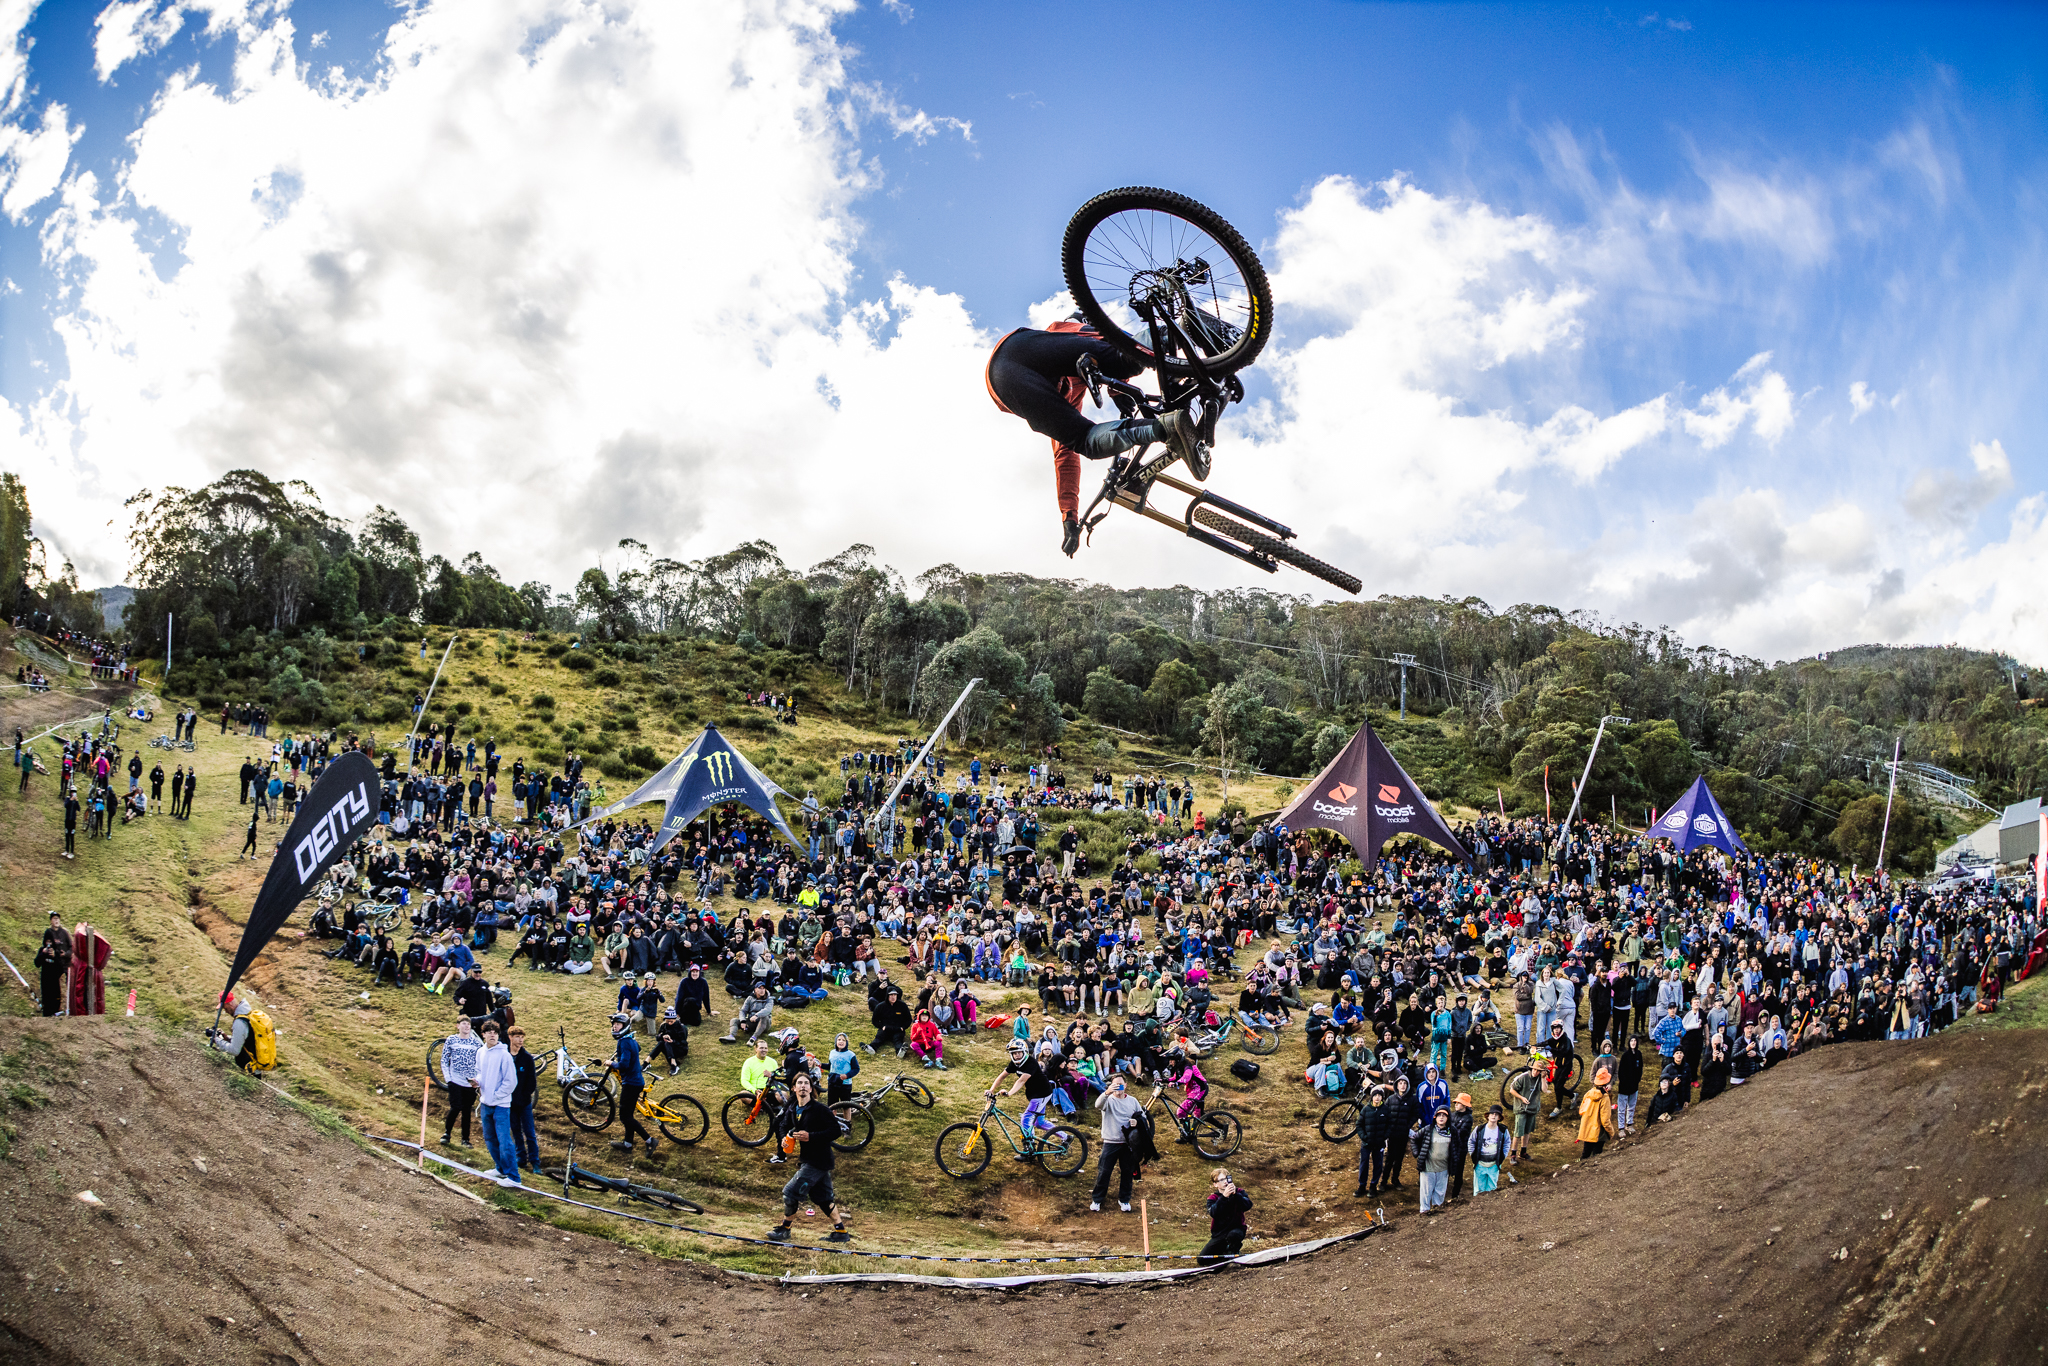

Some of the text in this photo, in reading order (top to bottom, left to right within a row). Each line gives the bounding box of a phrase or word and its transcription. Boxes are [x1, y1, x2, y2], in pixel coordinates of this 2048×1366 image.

[1251, 294, 1260, 339] MAXXIS
[1139, 456, 1173, 484] SANTA
[702, 788, 747, 800] MONSTER
[1313, 800, 1358, 816] boost
[1375, 804, 1416, 817] boost
[1319, 813, 1344, 821] mobile
[293, 781, 370, 885] DEITY
